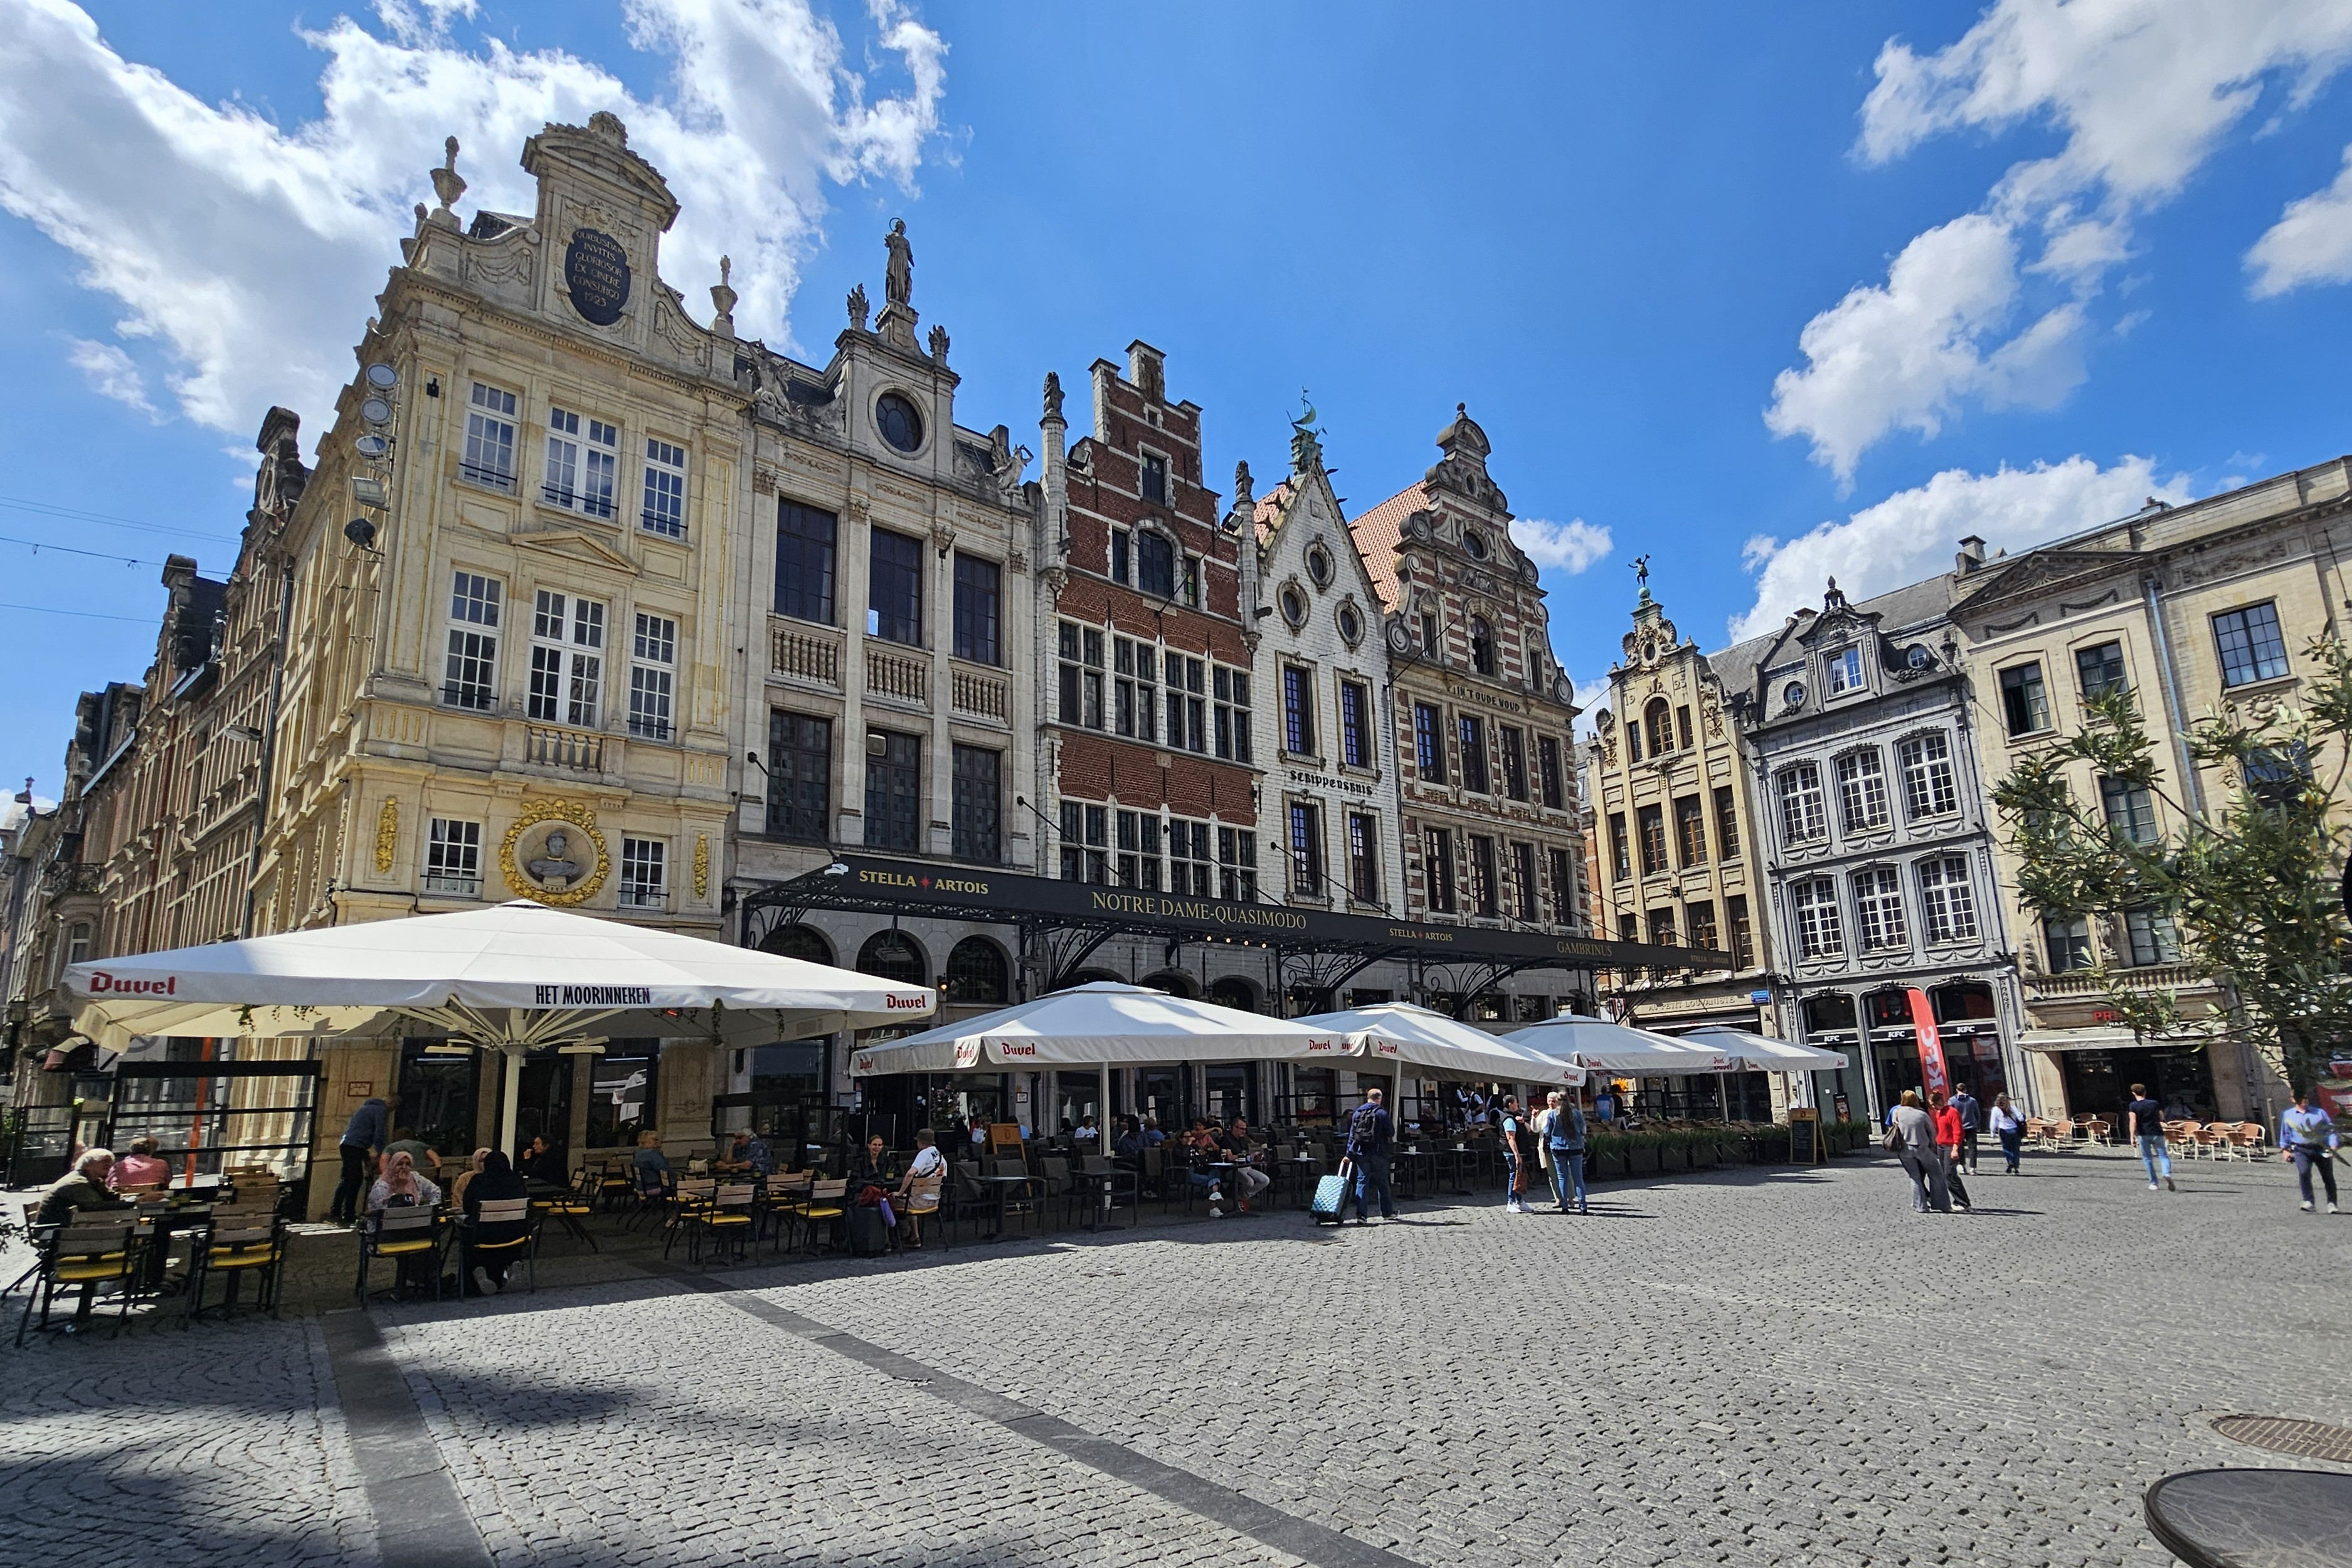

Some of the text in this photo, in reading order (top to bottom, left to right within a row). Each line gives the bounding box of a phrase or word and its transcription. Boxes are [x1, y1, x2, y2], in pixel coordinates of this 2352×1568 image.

[584, 242, 616, 262] INVITIS
[575, 252, 622, 277] GLORIOSOR
[575, 263, 620, 289] EX CINERE
[573, 275, 620, 300] CONSURGO
[1475, 692, 1496, 706] OUDE
[1498, 697, 1520, 712] WOUD
[859, 870, 989, 894] STELLA ARTOIS
[1091, 891, 1307, 930] NOTRE DAME-QUASIMODO
[1389, 928, 1453, 941] STELLA ARTOIS
[1557, 941, 1613, 957] GAMBRINUS
[90, 971, 176, 995] Duvel
[536, 985, 651, 1005] HET MOORINNEKEN
[886, 993, 927, 1009] Duvel
[1888, 1030, 1905, 1039] KFC
[1956, 1025, 1976, 1034] KFC
[1002, 1042, 1036, 1056] Duvel
[1309, 1039, 1331, 1050] Duvel
[1920, 1025, 1944, 1089] KFC
